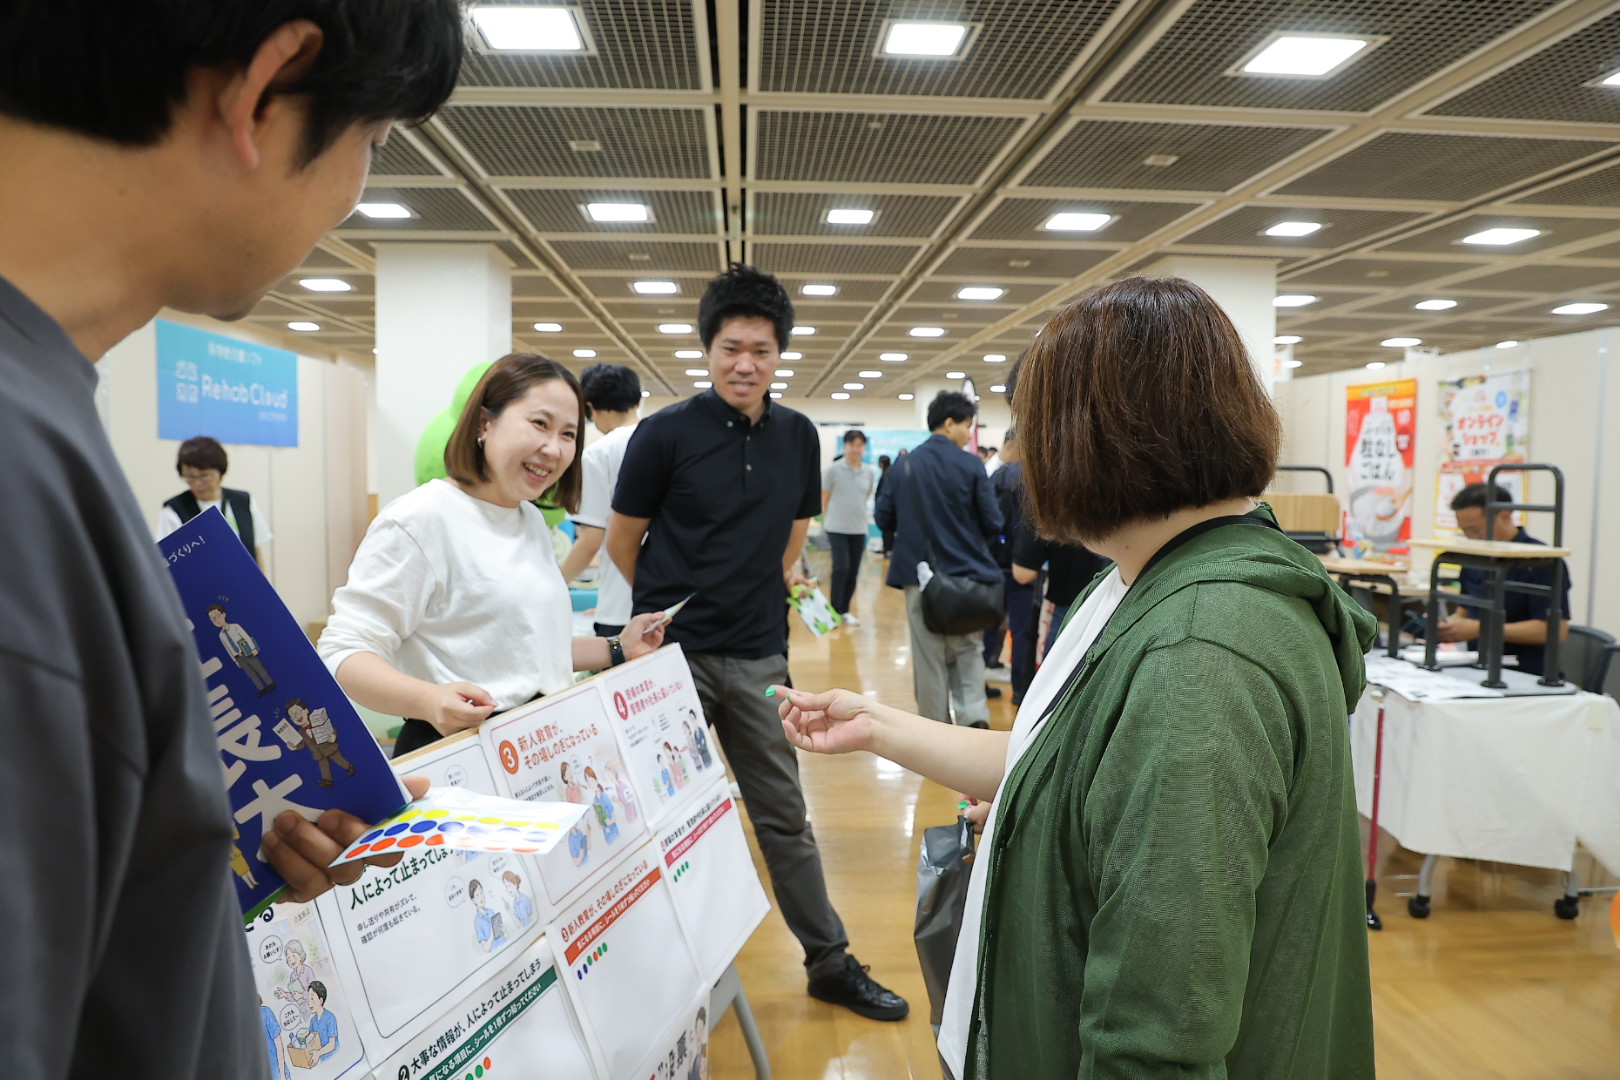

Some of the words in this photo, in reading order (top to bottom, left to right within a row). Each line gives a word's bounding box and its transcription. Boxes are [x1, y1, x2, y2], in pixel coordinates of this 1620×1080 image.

[201, 373, 249, 404] Rehab
[250, 382, 288, 409] Cloud
[1457, 413, 1504, 430] オンライン
[517, 721, 563, 752] 新人教育が、
[523, 723, 599, 769] その場しのぎになっている
[502, 746, 517, 770] 3
[351, 848, 453, 910] 人によって止まってしま
[357, 893, 417, 932] 申し送りや共有がズレて、
[360, 905, 421, 945] 確認が何度も起きている。
[411, 958, 541, 1074] 大事な情報が、人によって止まってしまう
